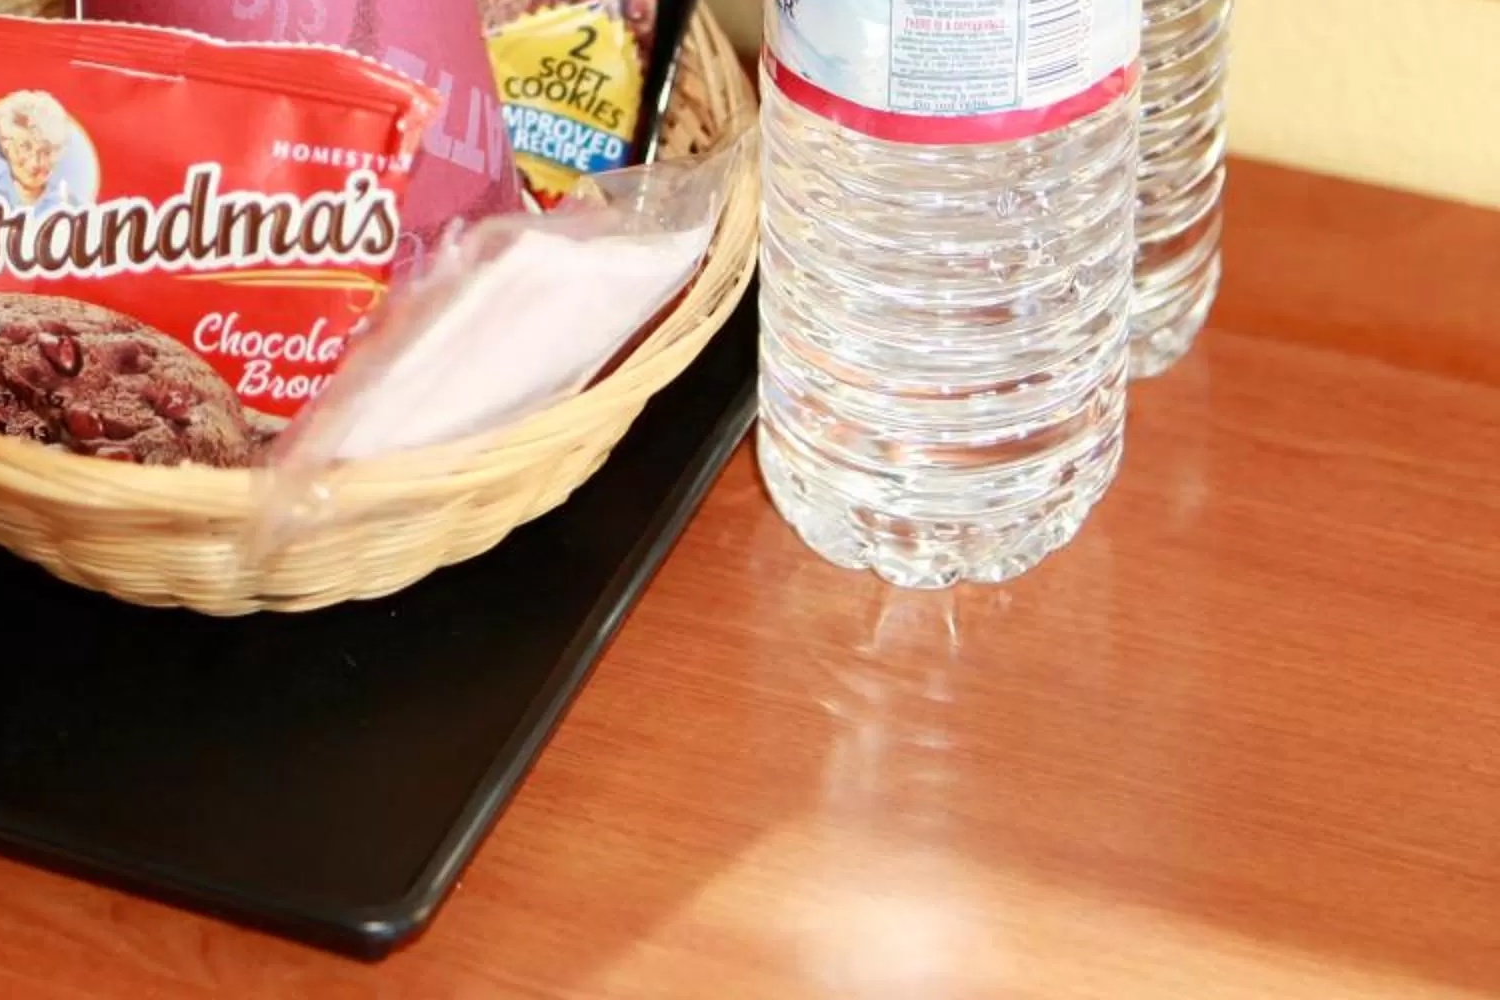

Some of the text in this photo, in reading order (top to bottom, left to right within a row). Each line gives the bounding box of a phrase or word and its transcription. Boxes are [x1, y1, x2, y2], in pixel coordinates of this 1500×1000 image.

[568, 25, 597, 61] 2
[539, 56, 612, 93] SOFT
[504, 76, 625, 129] COOKIES
[502, 105, 624, 160] MPROVED
[514, 129, 591, 171] RECIPE
[193, 312, 369, 362] Chocola
